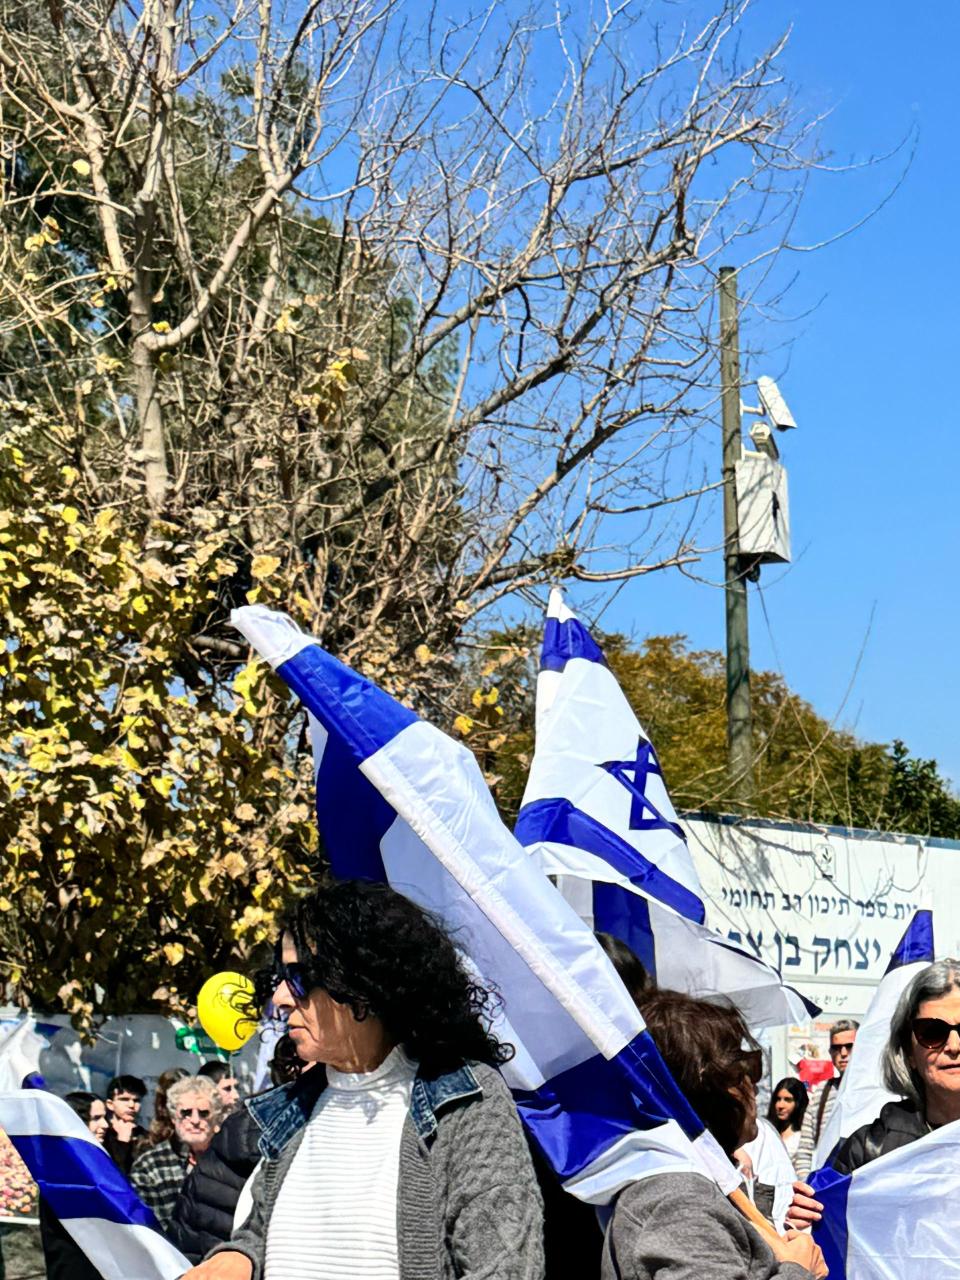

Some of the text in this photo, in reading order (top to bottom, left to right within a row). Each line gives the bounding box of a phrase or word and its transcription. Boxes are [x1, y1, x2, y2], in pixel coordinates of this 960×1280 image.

[721, 886, 775, 911] תחומי
[808, 894, 850, 918] תיכון
[855, 900, 888, 919] ספר
[893, 902, 918, 920] ית
[773, 931, 802, 975] בן
[812, 934, 881, 976] יצחק
